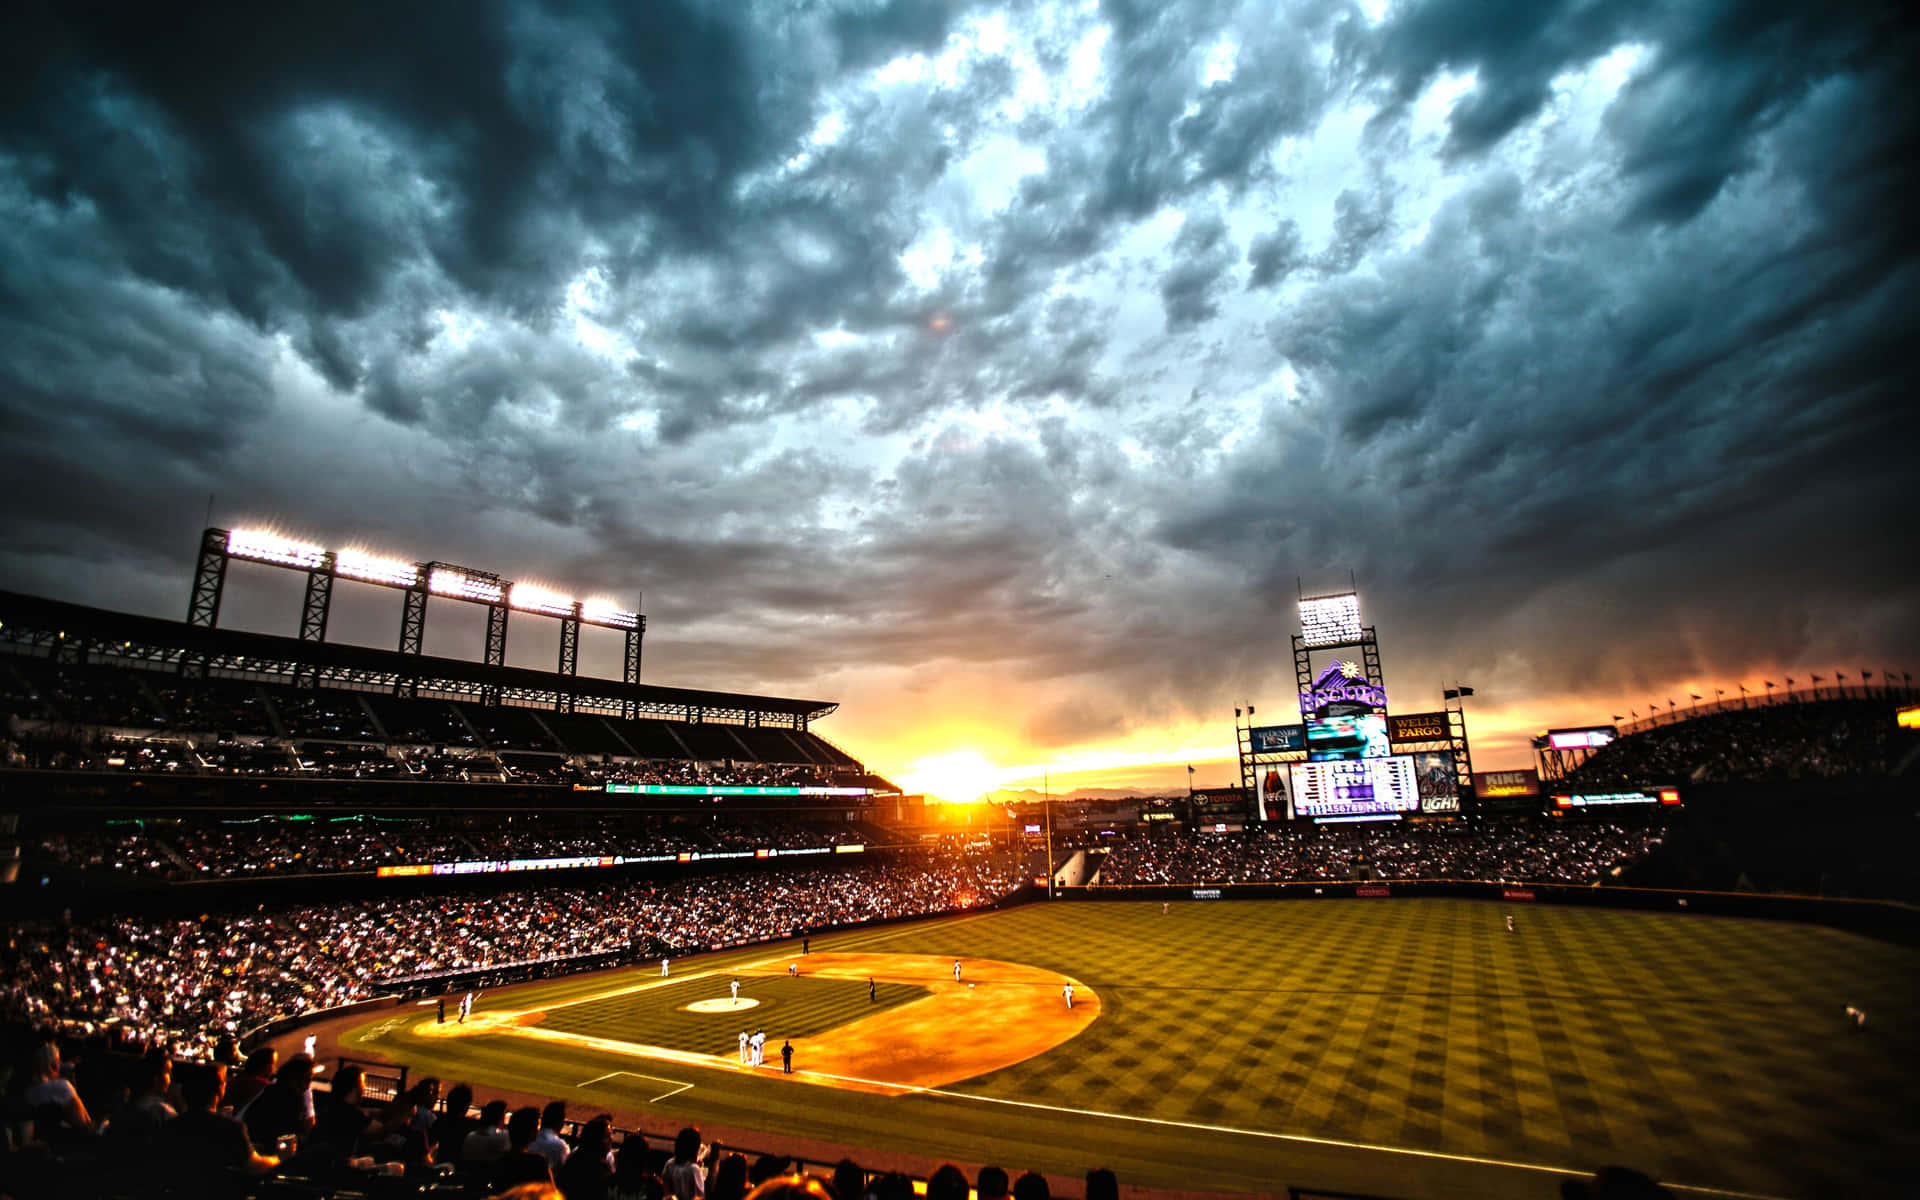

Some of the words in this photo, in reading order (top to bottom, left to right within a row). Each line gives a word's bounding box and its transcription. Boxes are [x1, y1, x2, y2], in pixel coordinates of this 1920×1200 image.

[1297, 686, 1388, 713] ROCKIES
[1396, 717, 1441, 728] WELLS
[1398, 727, 1443, 737] FARGO
[1486, 773, 1526, 785] KING
[1208, 794, 1242, 804] TOYOTA
